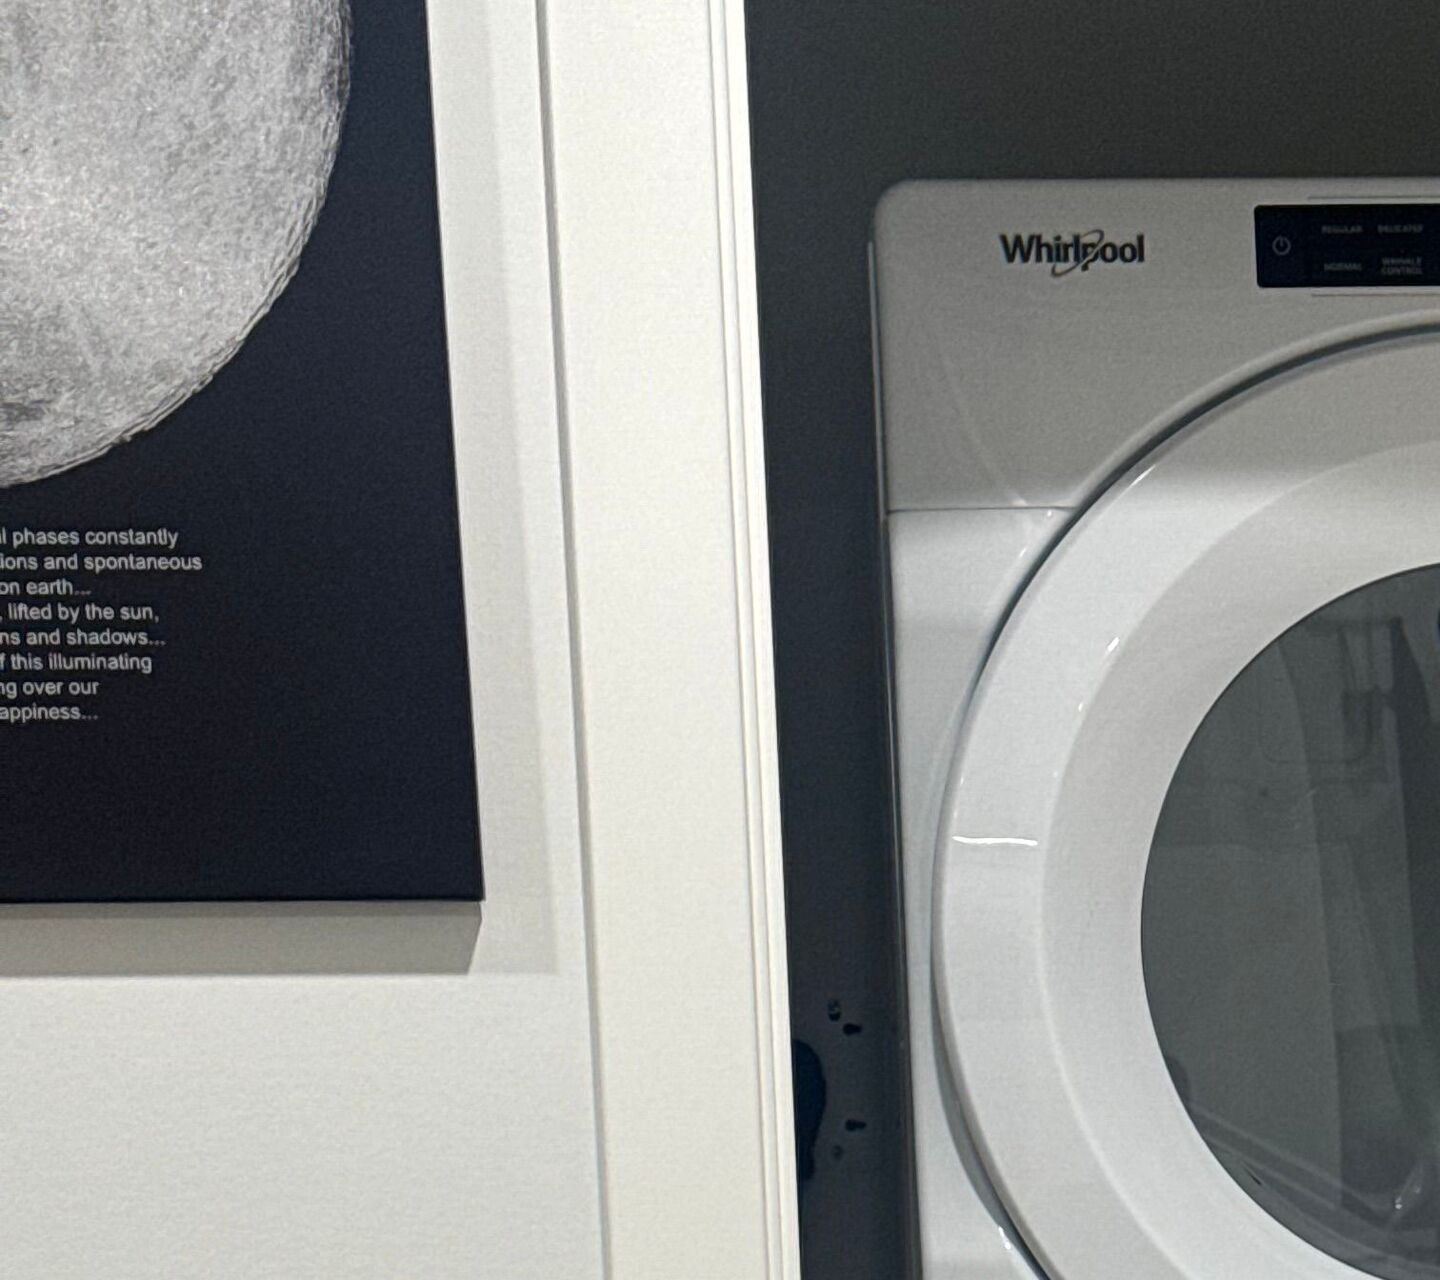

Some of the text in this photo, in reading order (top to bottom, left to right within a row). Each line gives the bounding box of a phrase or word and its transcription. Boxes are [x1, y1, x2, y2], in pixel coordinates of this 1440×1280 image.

[1321, 225, 1363, 234] REGULAR
[1000, 233, 1145, 272] Whirlpool
[1323, 263, 1362, 272] NORMAL
[13, 527, 80, 549] phases
[85, 527, 178, 549] constantly
[43, 553, 78, 570] and
[84, 555, 203, 574] spontaneous
[0, 578, 92, 595] on earth...
[8, 602, 51, 620] lifted
[57, 602, 80, 624] by
[85, 602, 114, 620] the
[120, 606, 159, 623] sun,
[26, 629, 60, 645] and
[66, 628, 166, 646] shadows...
[11, 652, 43, 670] this
[49, 652, 152, 673] illuminating
[22, 682, 62, 695] over
[69, 682, 99, 695] our
[0, 702, 98, 723] appiness...
